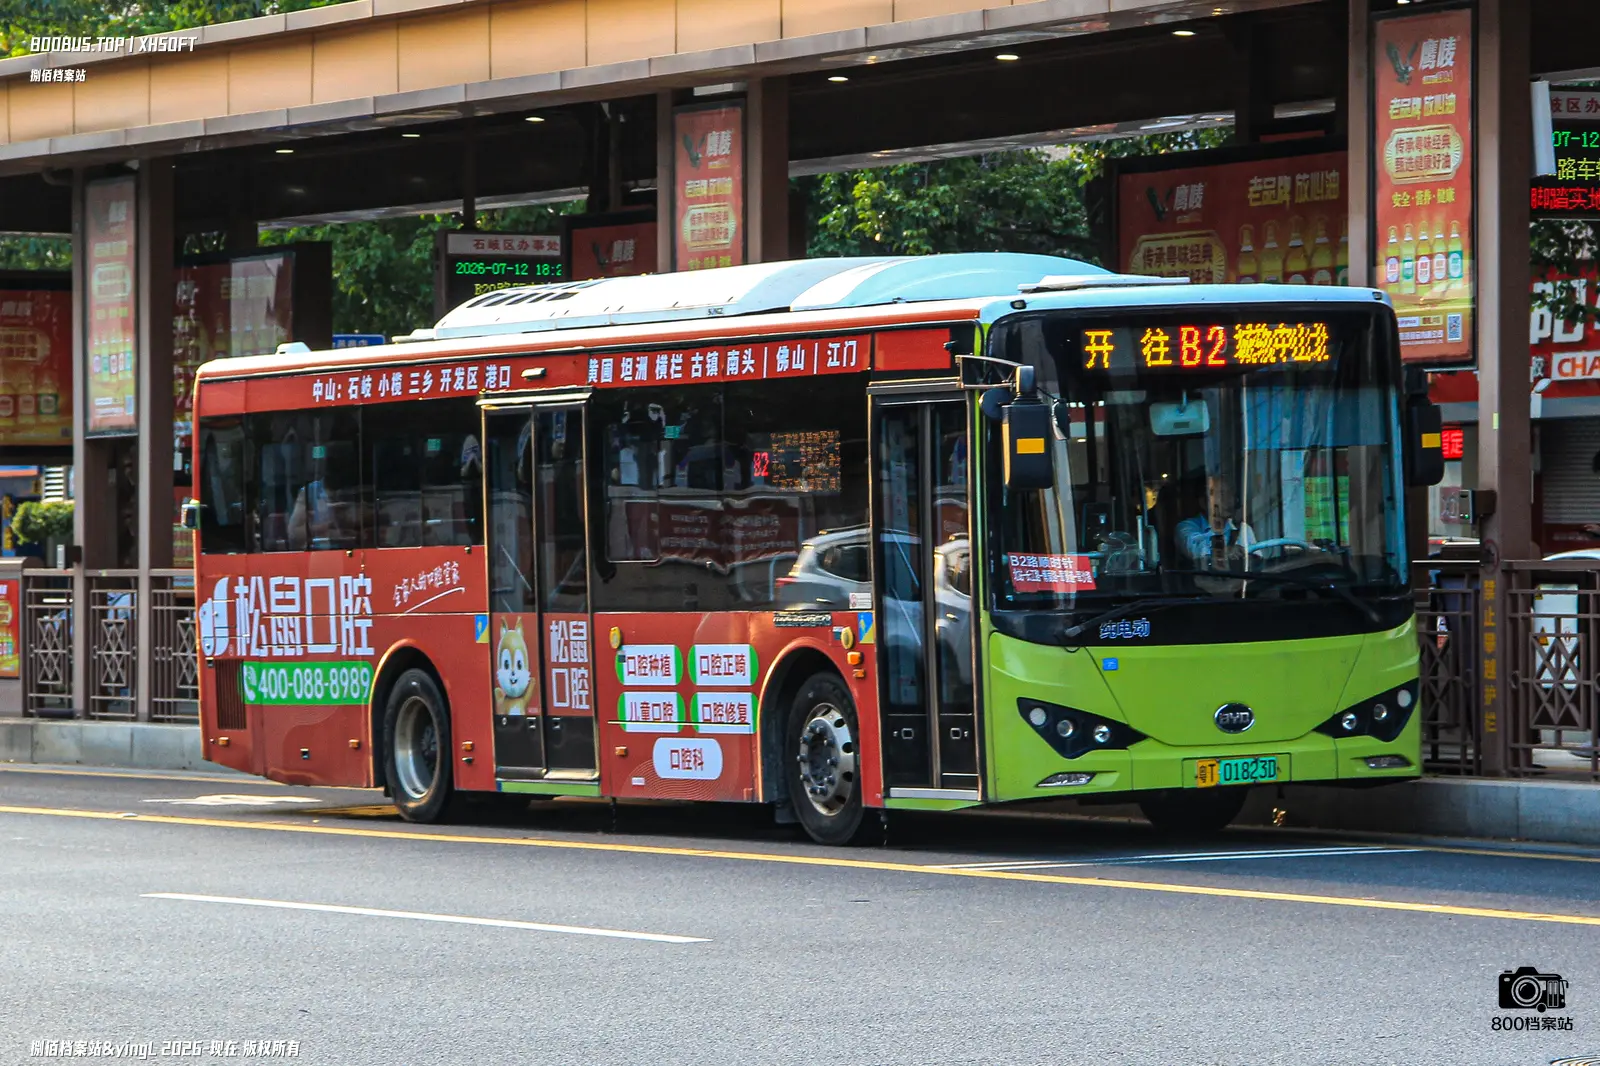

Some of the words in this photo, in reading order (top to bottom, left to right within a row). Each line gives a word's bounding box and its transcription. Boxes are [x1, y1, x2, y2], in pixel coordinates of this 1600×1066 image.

[1558, 157, 1600, 180] 路车
[473, 238, 560, 251] 石岐区办事处
[456, 263, 528, 275] 2026-07-12
[1180, 326, 1226, 366] B2
[620, 355, 647, 382] 坦洲
[655, 353, 682, 380] 横栏
[690, 351, 718, 378] 古镇
[726, 348, 755, 376] 南头
[776, 344, 804, 371] 佛山
[827, 341, 857, 367] 江门
[348, 375, 372, 399] 石岐
[378, 373, 403, 398] 小榄
[409, 369, 434, 395] 三乡
[440, 366, 479, 392] 开发区
[485, 364, 511, 389] 港口
[1009, 555, 1074, 569] B2路顺时针
[234, 573, 375, 657] 松鼠口腔
[1100, 618, 1151, 639] 纯电动
[550, 620, 588, 663] 松鼠
[626, 653, 672, 677] 口腔种植
[699, 653, 746, 677] 口腔正畸
[258, 667, 370, 700] 400-088-8989
[551, 667, 590, 710] 口腔
[629, 701, 674, 722] 儿童口腔
[701, 702, 748, 724] 口腔修复
[1219, 712, 1250, 724] BYD
[669, 748, 704, 771] 口腔科
